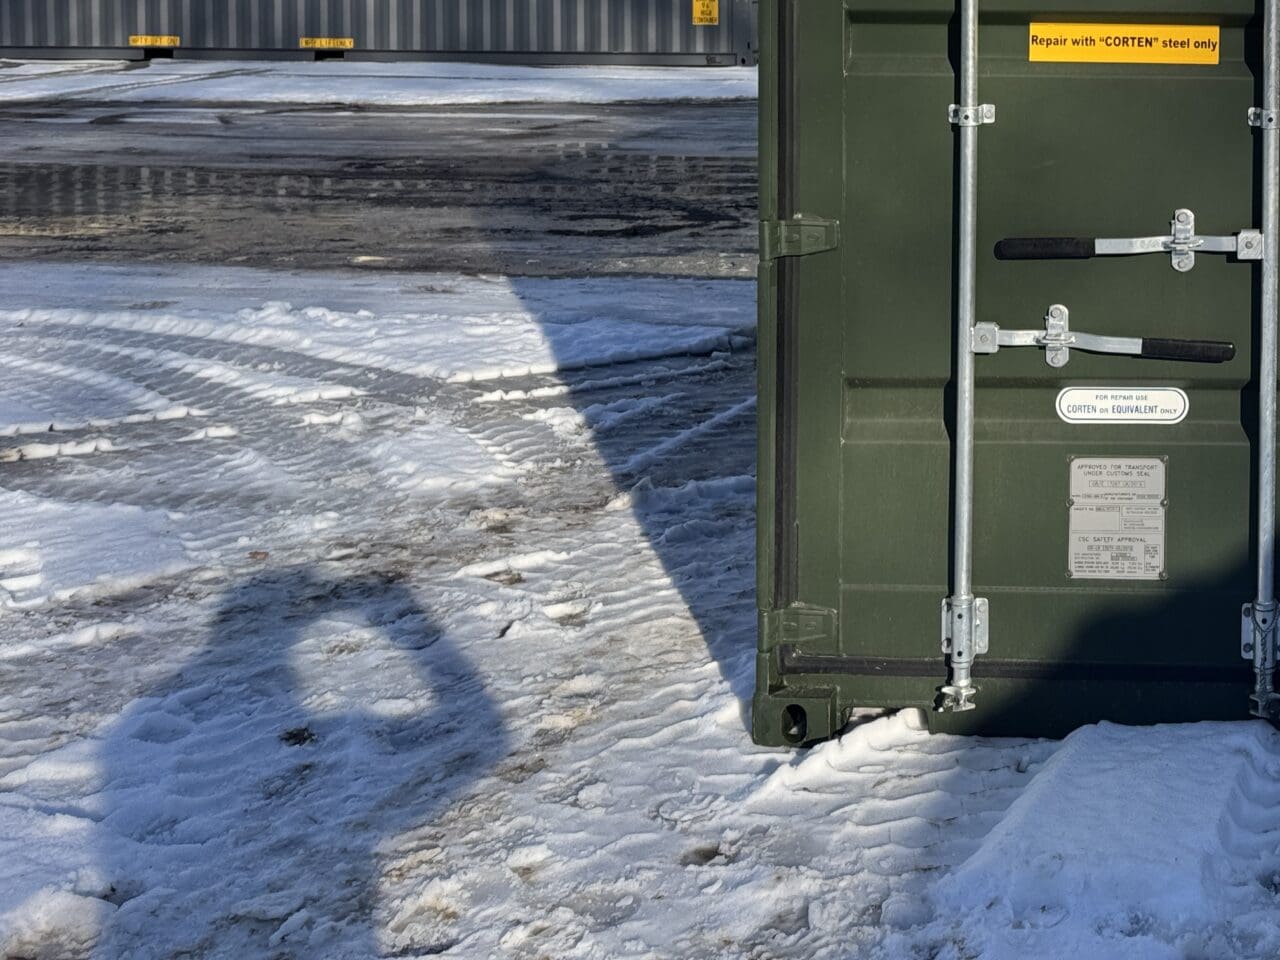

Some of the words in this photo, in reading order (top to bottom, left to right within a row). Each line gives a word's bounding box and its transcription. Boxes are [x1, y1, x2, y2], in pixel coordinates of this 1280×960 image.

[1031, 35, 1068, 48] Repair
[1071, 36, 1096, 47] with
[1162, 38, 1190, 49] steel
[1194, 38, 1217, 52] only
[1067, 404, 1097, 414] CORTEN
[1111, 405, 1158, 414] EQUIVALENT
